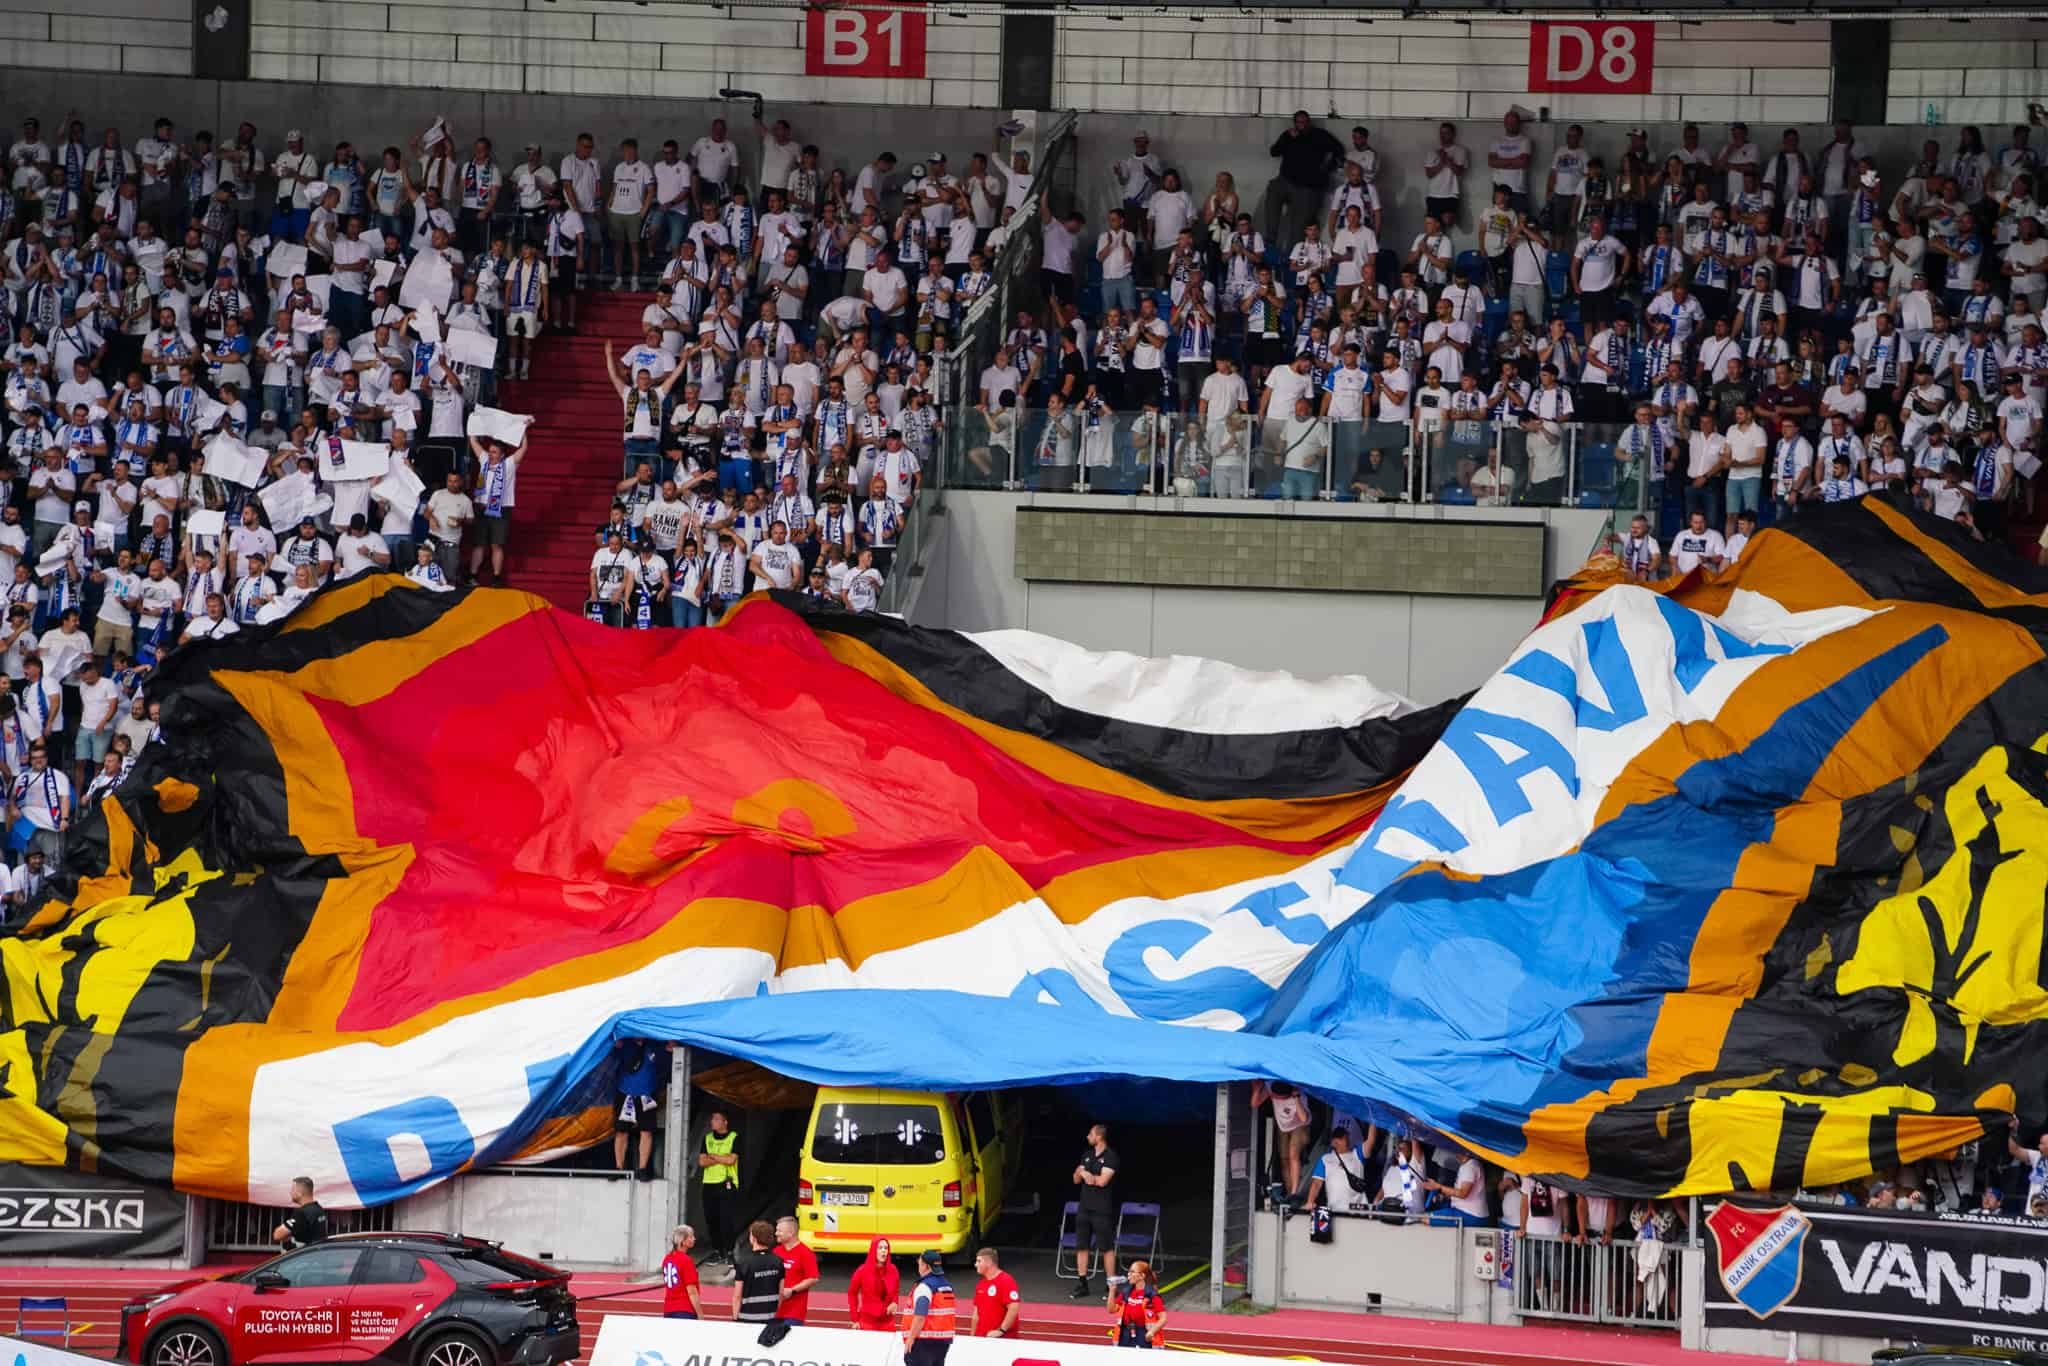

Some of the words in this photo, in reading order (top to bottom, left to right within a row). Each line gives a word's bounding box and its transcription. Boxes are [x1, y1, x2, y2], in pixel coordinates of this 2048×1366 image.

[823, 10, 902, 67] B1
[1546, 25, 1636, 83] D8
[1729, 1221, 1746, 1239] FC
[1728, 1253, 1759, 1287] BANÍK
[1756, 1214, 1799, 1258] OSTRAVA
[1820, 1238, 2048, 1315] VAND
[244, 1322, 290, 1334] PLUG-IN
[292, 1323, 333, 1334] HYBRID
[261, 1310, 302, 1321] TOYOTA
[305, 1311, 333, 1321] C-HR
[1971, 1334, 1991, 1347] FC
[1994, 1336, 2036, 1352] BANÍK
